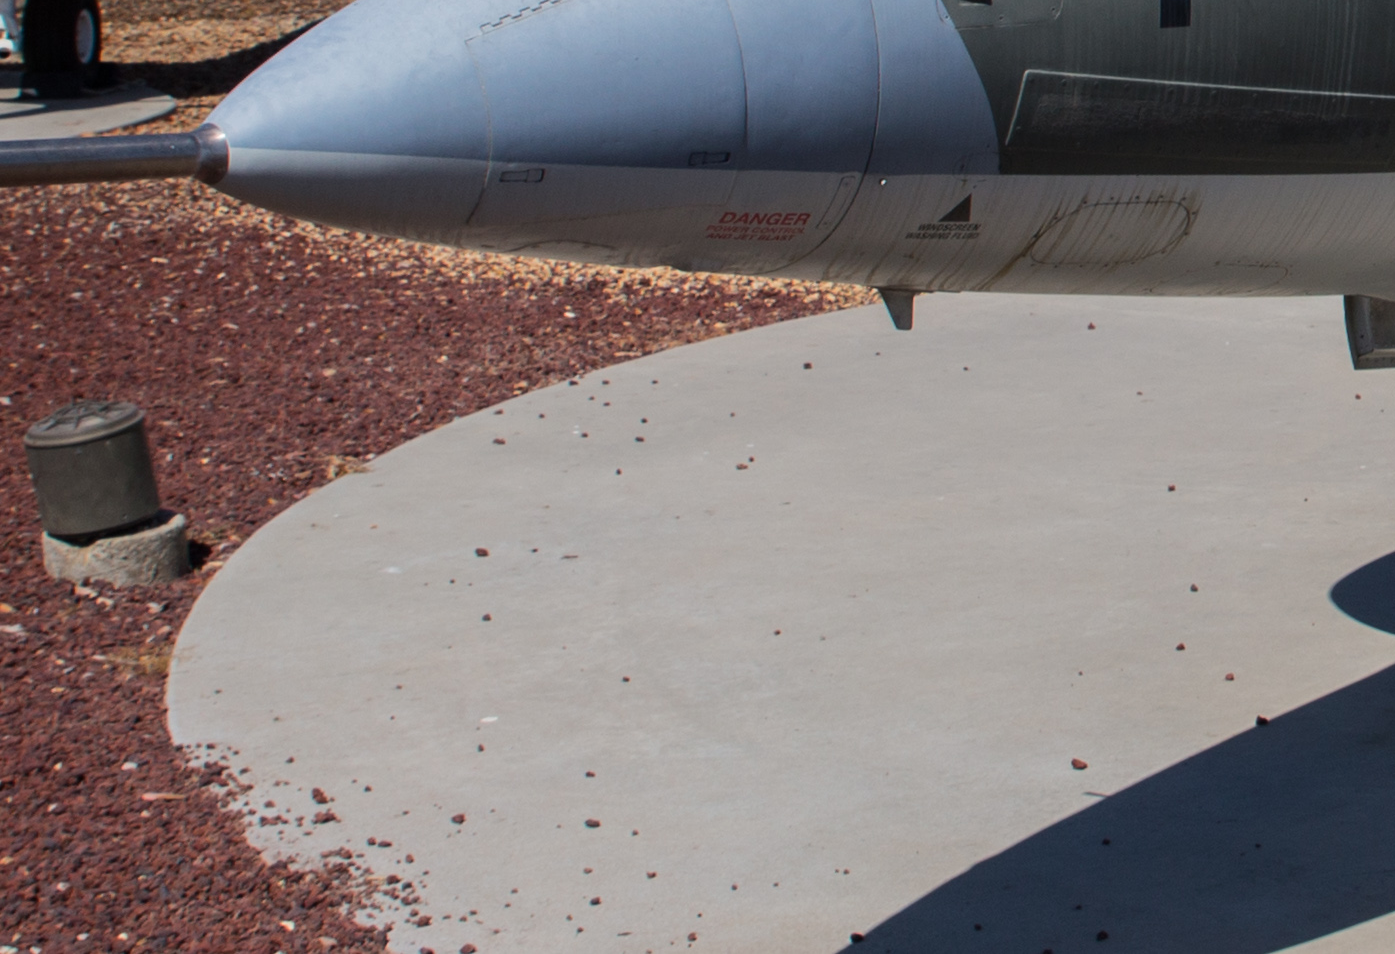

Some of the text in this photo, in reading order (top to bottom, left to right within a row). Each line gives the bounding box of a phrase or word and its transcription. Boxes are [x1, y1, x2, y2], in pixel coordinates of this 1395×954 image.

[719, 211, 811, 226] DANGER
[705, 225, 805, 235] POWER CONTROL
[918, 223, 981, 233] WINDSCREEN
[705, 233, 796, 242] AND JET BLAST
[904, 231, 980, 241] WASHING FLUID
